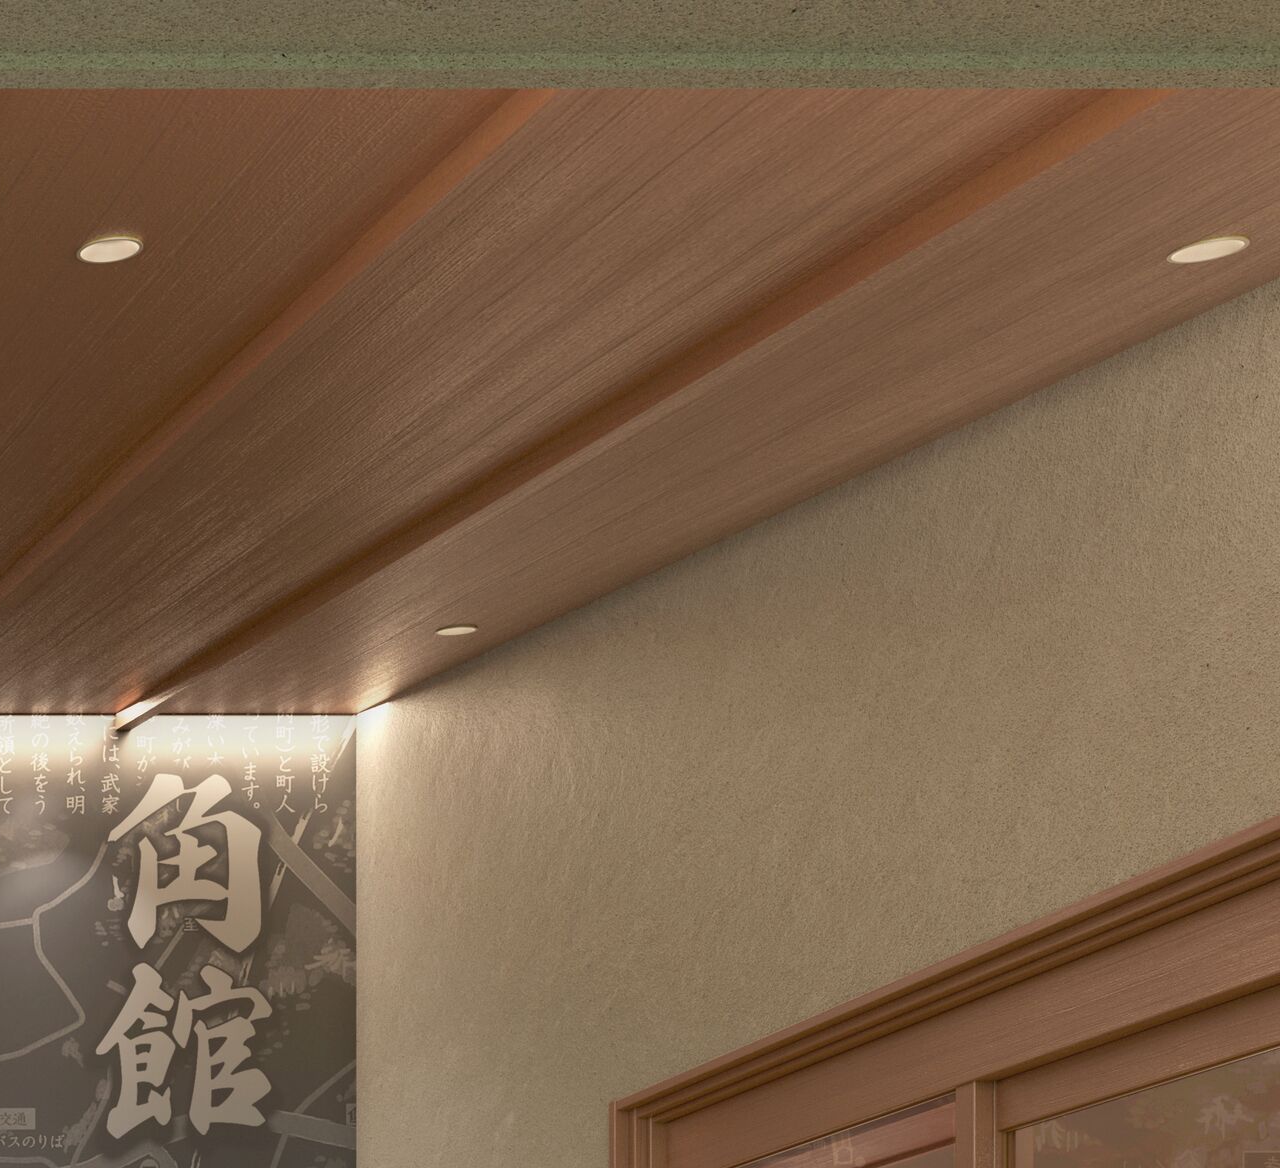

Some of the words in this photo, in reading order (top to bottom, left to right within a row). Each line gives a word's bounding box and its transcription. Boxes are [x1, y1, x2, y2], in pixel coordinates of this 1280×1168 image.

[100, 714, 120, 815] には、武家
[241, 714, 261, 809] ています。
[96, 772, 273, 1139] 角館
